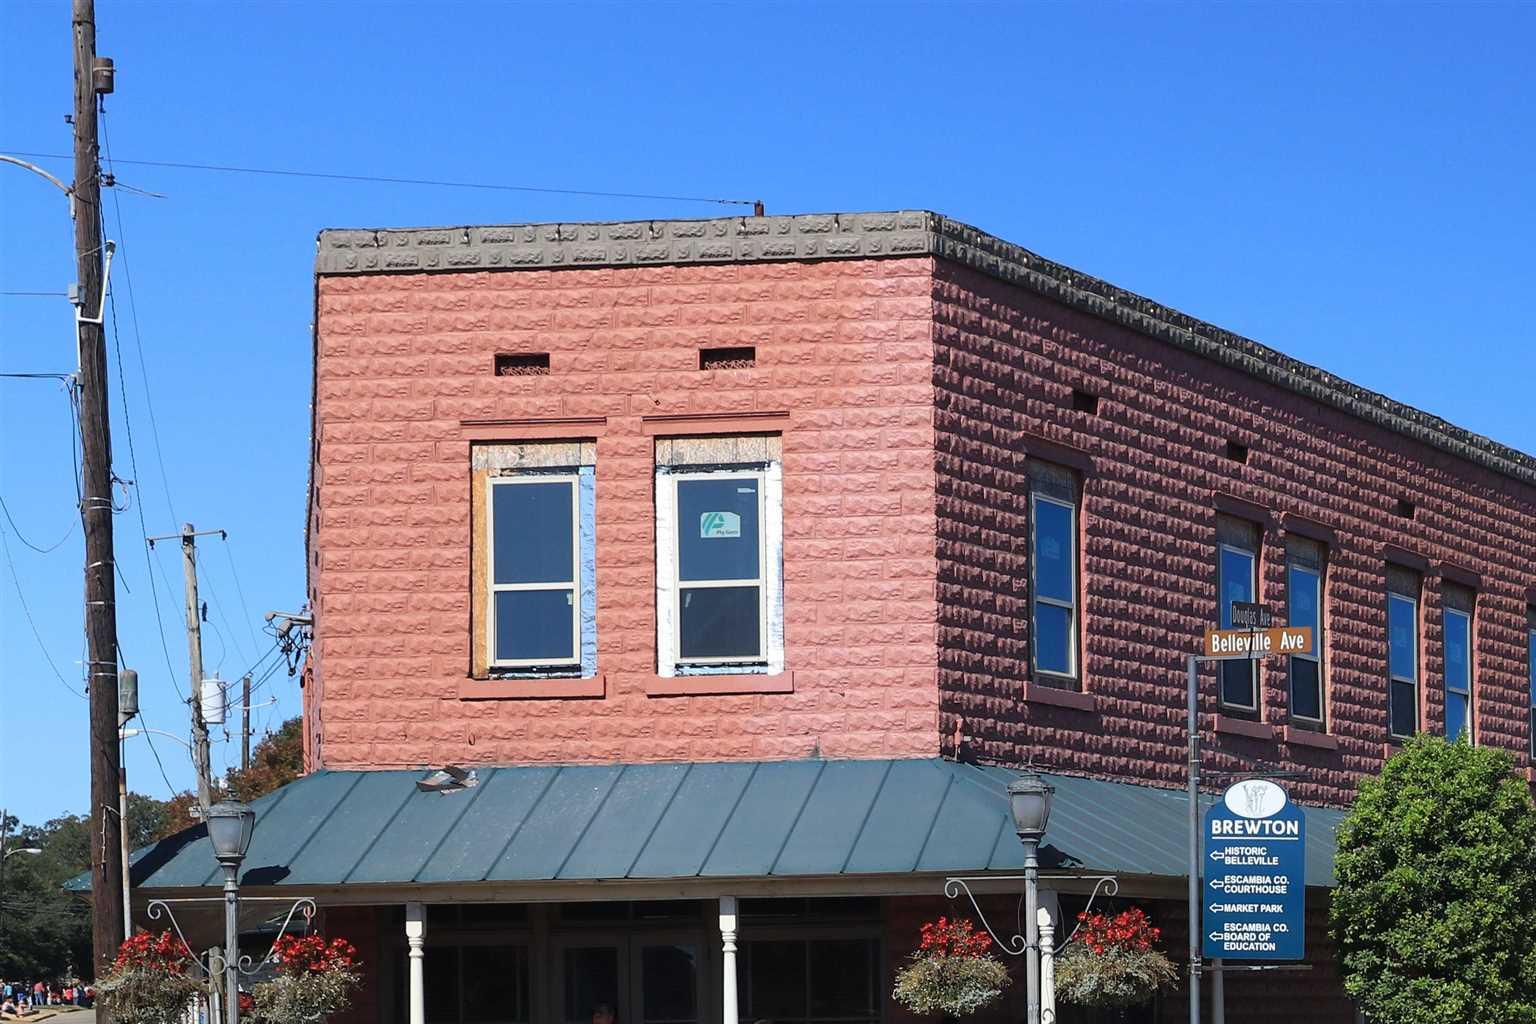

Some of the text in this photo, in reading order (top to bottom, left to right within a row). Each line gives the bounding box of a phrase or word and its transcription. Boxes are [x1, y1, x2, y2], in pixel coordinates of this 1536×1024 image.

[1212, 631, 1304, 652] Belleville Ave
[1211, 819, 1299, 835] BREWTON
[1224, 846, 1267, 855] HISTORIC
[1224, 856, 1279, 865] BELLEVILLE
[1224, 875, 1290, 884] ESCAMBIA CO.
[1224, 885, 1287, 894] COURTHOUSE
[1223, 904, 1283, 913] MARKET PARK
[1223, 923, 1289, 932] ESCAMBIA CO.
[1223, 932, 1271, 941] BOARD OF
[1223, 942, 1276, 951] EDUCATION
